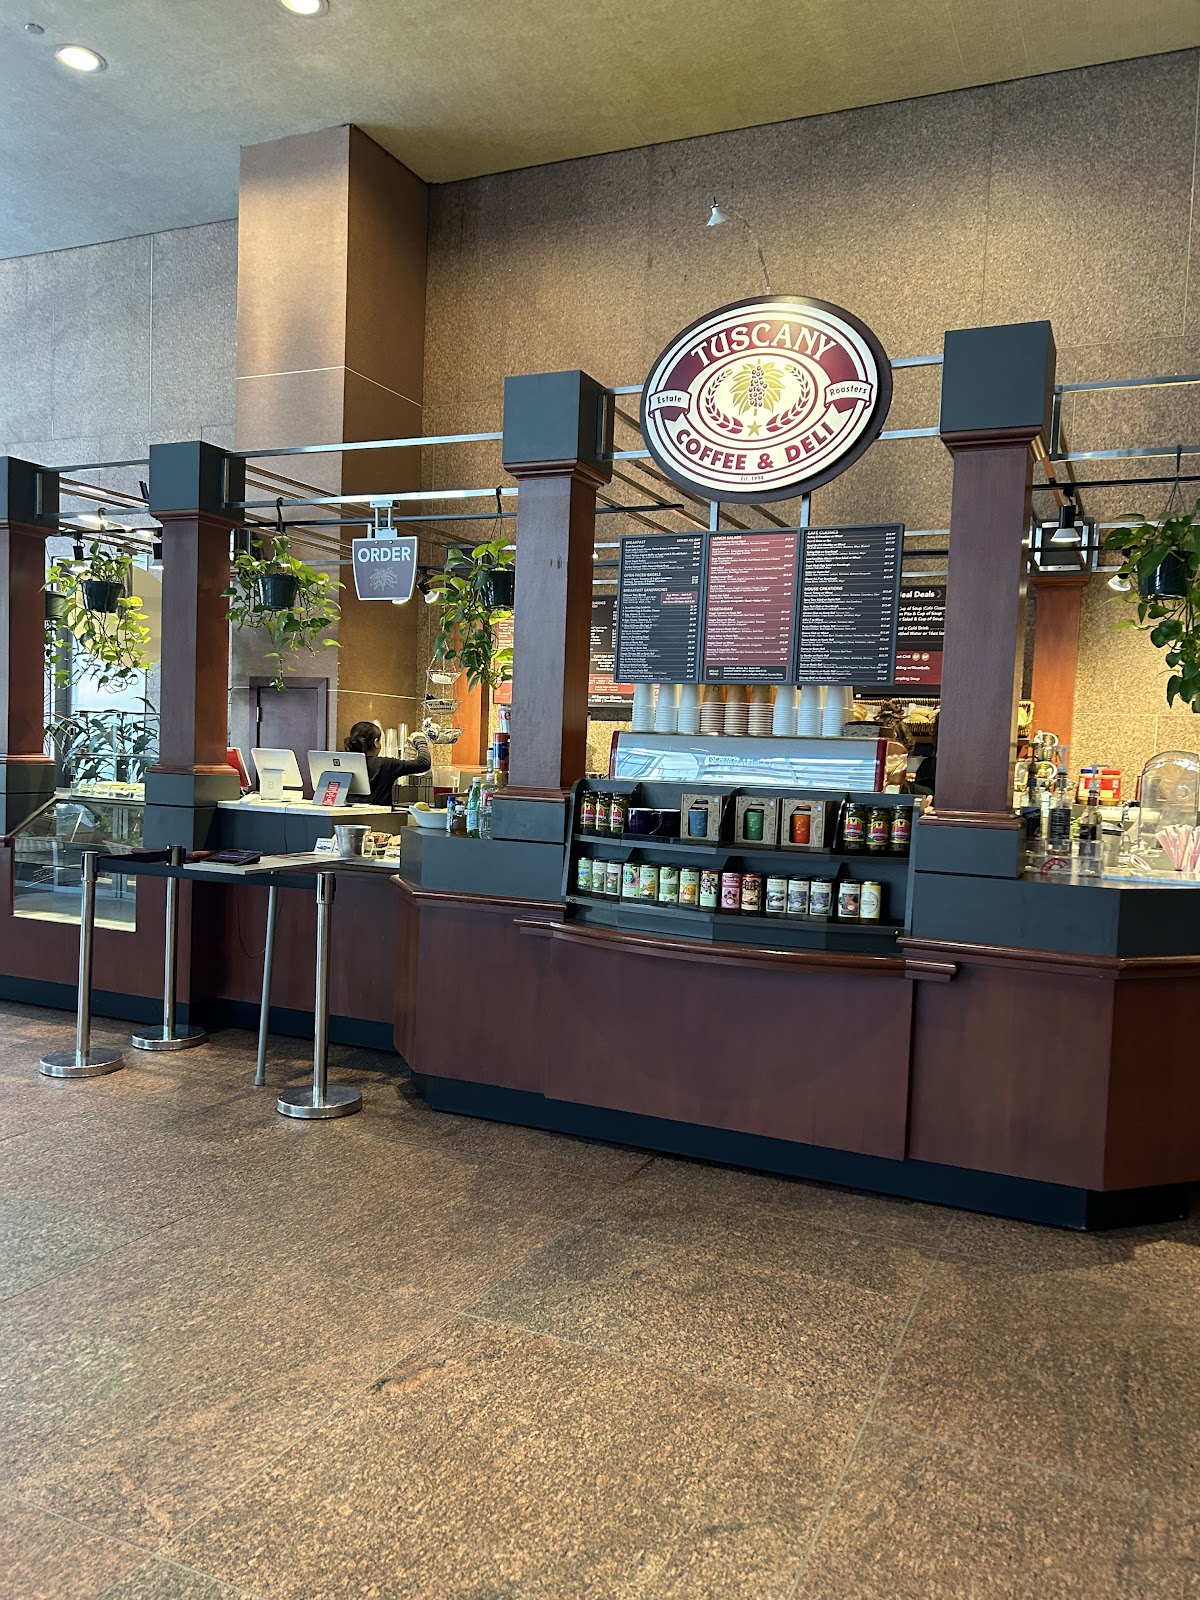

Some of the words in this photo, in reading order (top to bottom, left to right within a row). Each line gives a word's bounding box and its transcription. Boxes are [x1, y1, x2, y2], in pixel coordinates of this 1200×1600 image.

[691, 322, 836, 366] TUSCANY
[829, 386, 867, 396] Roasters
[656, 395, 682, 404] Estate
[676, 428, 746, 470] COFFEE
[757, 452, 775, 469] &
[784, 421, 834, 462] DELI
[357, 546, 411, 563] ORDER
[913, 589, 935, 597] Deals
